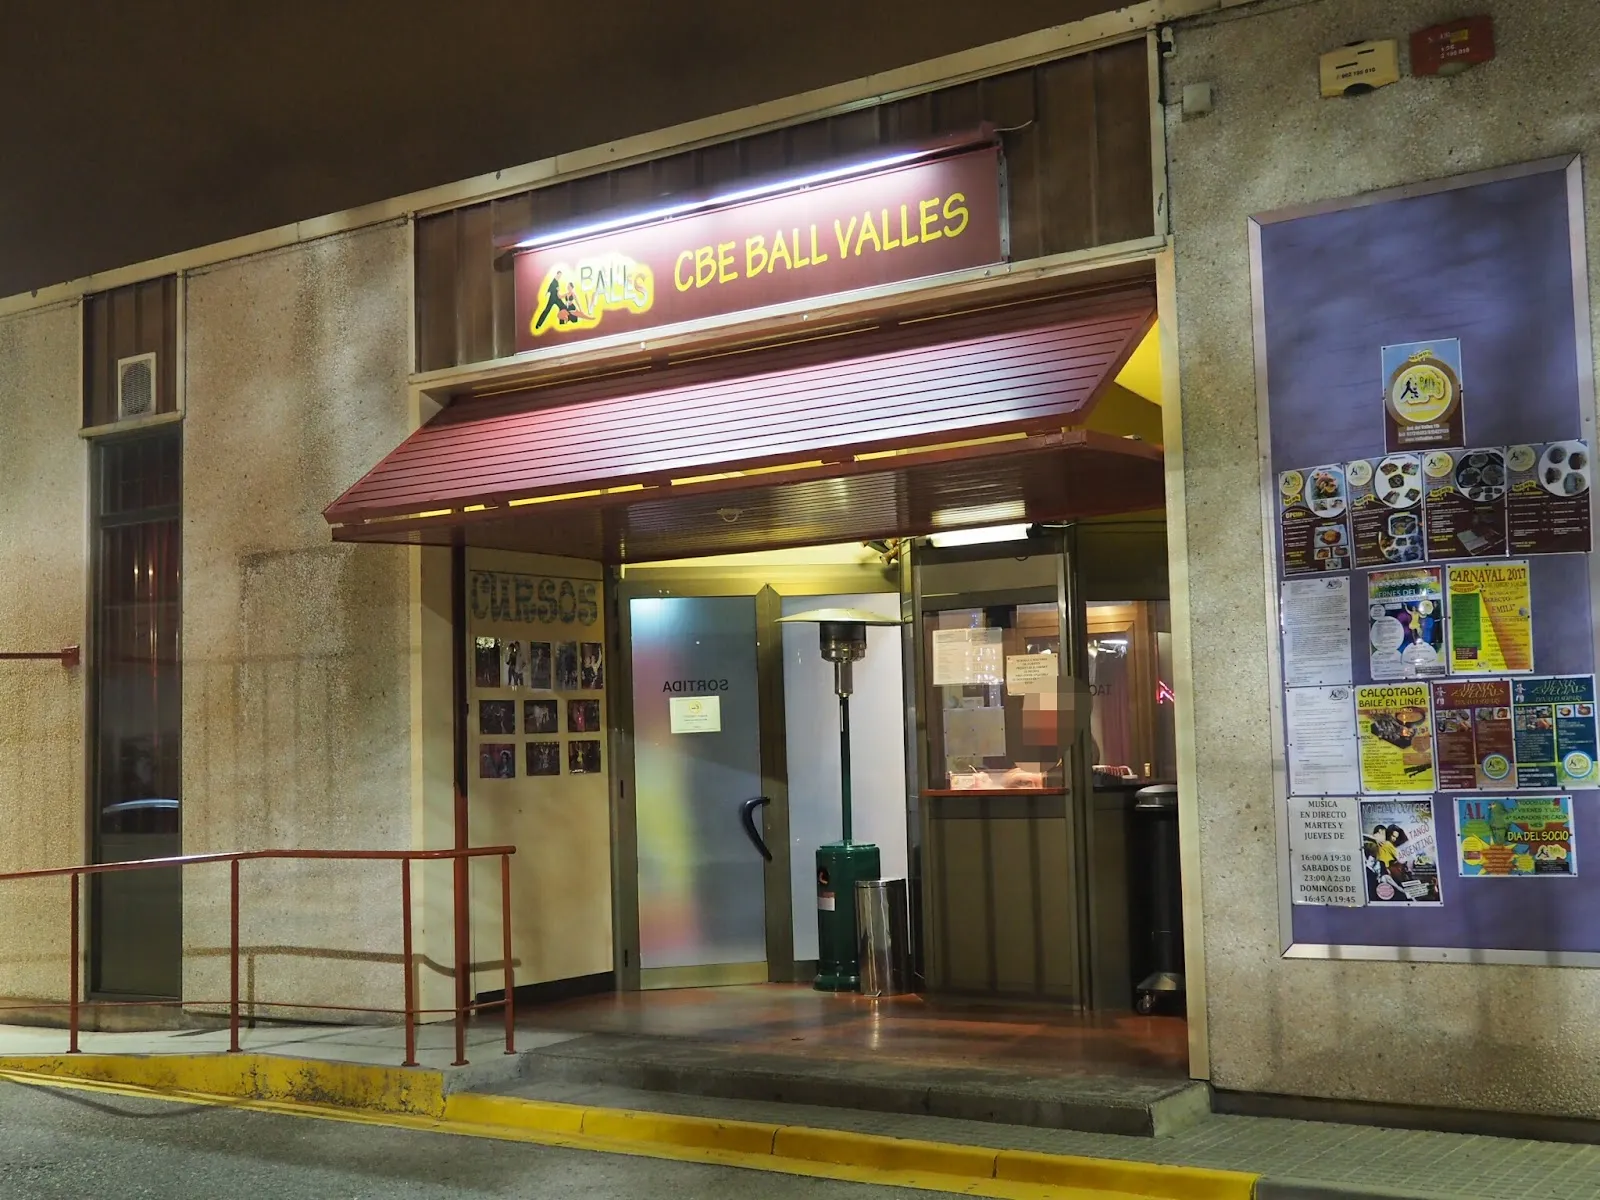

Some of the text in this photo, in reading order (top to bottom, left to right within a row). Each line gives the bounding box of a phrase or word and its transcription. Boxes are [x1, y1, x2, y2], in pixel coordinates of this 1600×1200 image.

[674, 192, 969, 292] CBE BALL VALLES
[1449, 567, 1526, 582] CARNAVAL 2017
[471, 572, 598, 627] CURSOS
[1360, 686, 1423, 700] CALÇOTADA
[1359, 698, 1426, 708] BAILE EN LINEA
[1308, 800, 1338, 808] MUSICA
[1300, 811, 1347, 819] EN DIRECTO
[1463, 802, 1486, 820] AL
[1409, 821, 1430, 839] TANGO
[1304, 832, 1345, 840] JUEVES DE
[1507, 830, 1569, 842] DIA DEL SOCIO
[1398, 835, 1434, 860] ARGENTINO
[1330, 854, 1352, 862] 19:30
[1301, 864, 1339, 872] SABADOS
[1334, 875, 1351, 883] 2:30
[1300, 884, 1357, 893] DOMINGOS DE
[1304, 895, 1356, 903] 16:45 A 19:45
